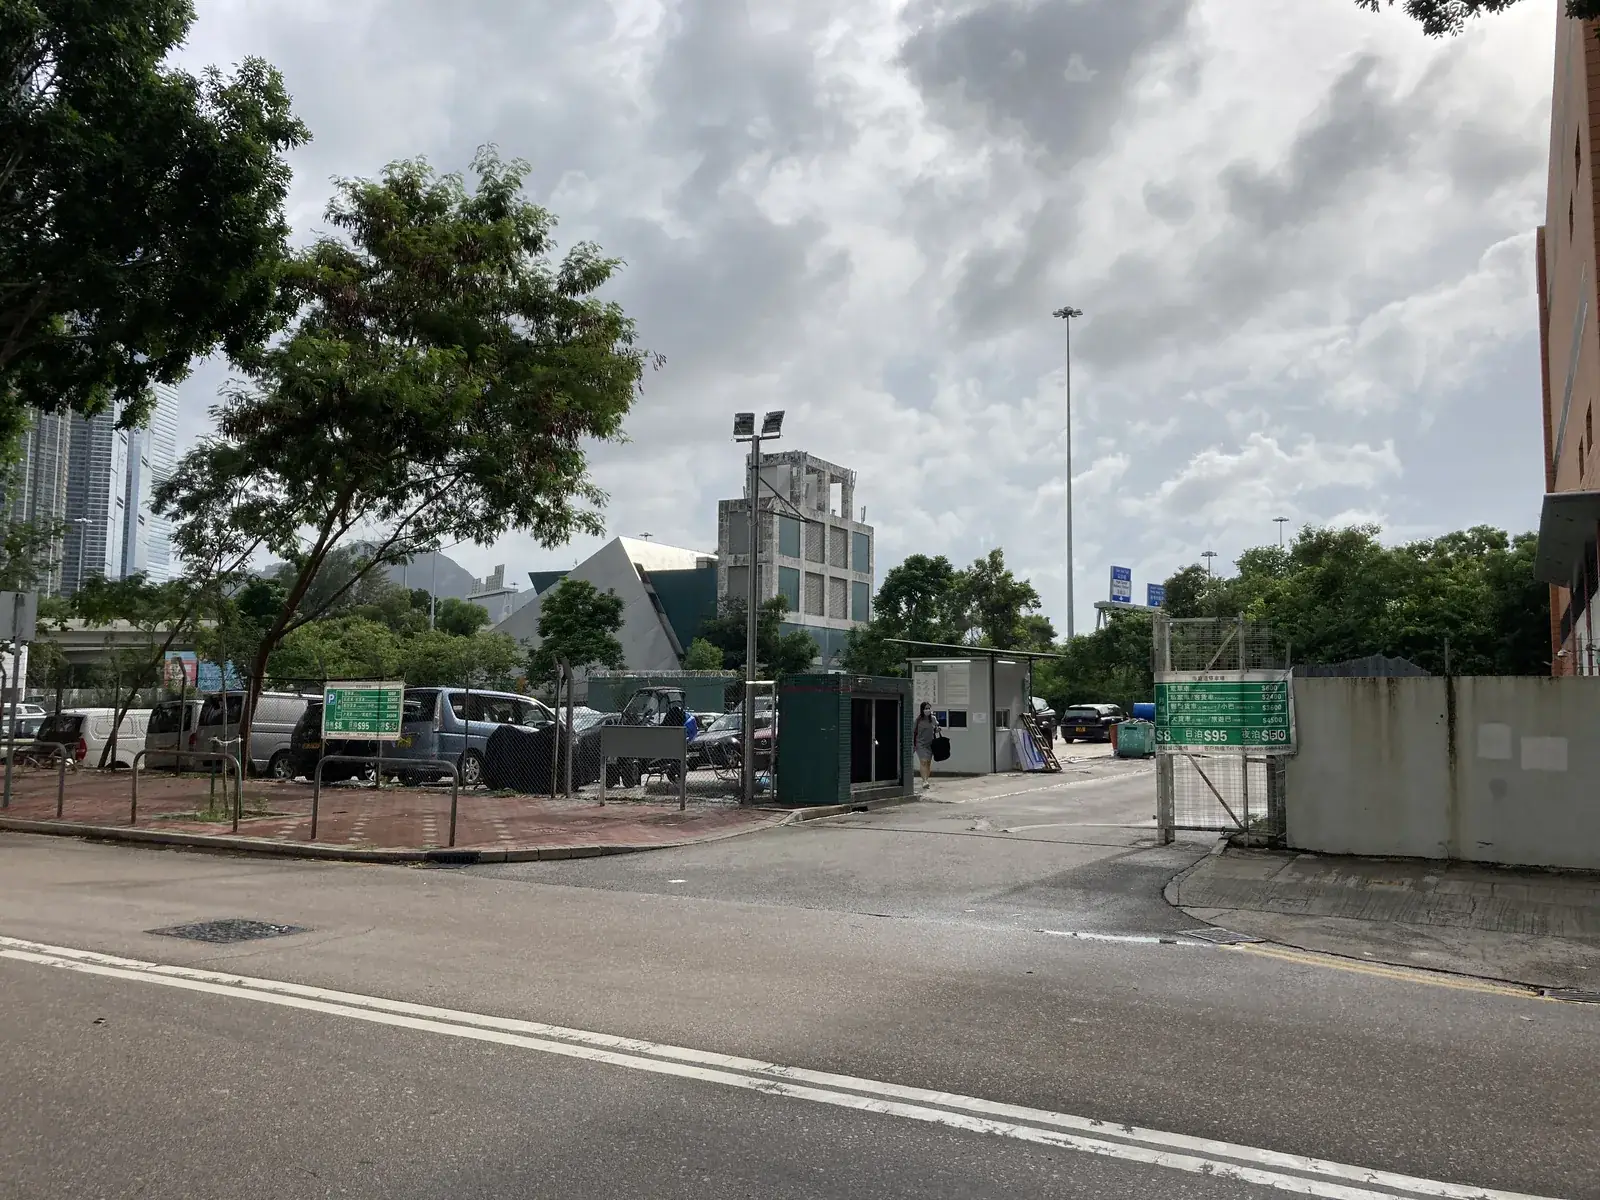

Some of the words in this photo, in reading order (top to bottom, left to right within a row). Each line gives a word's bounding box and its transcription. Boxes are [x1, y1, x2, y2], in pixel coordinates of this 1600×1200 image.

[357, 721, 370, 730] $95
[1262, 716, 1283, 724] $4500
[1204, 729, 1228, 742] $95
[1261, 729, 1286, 742] $50
